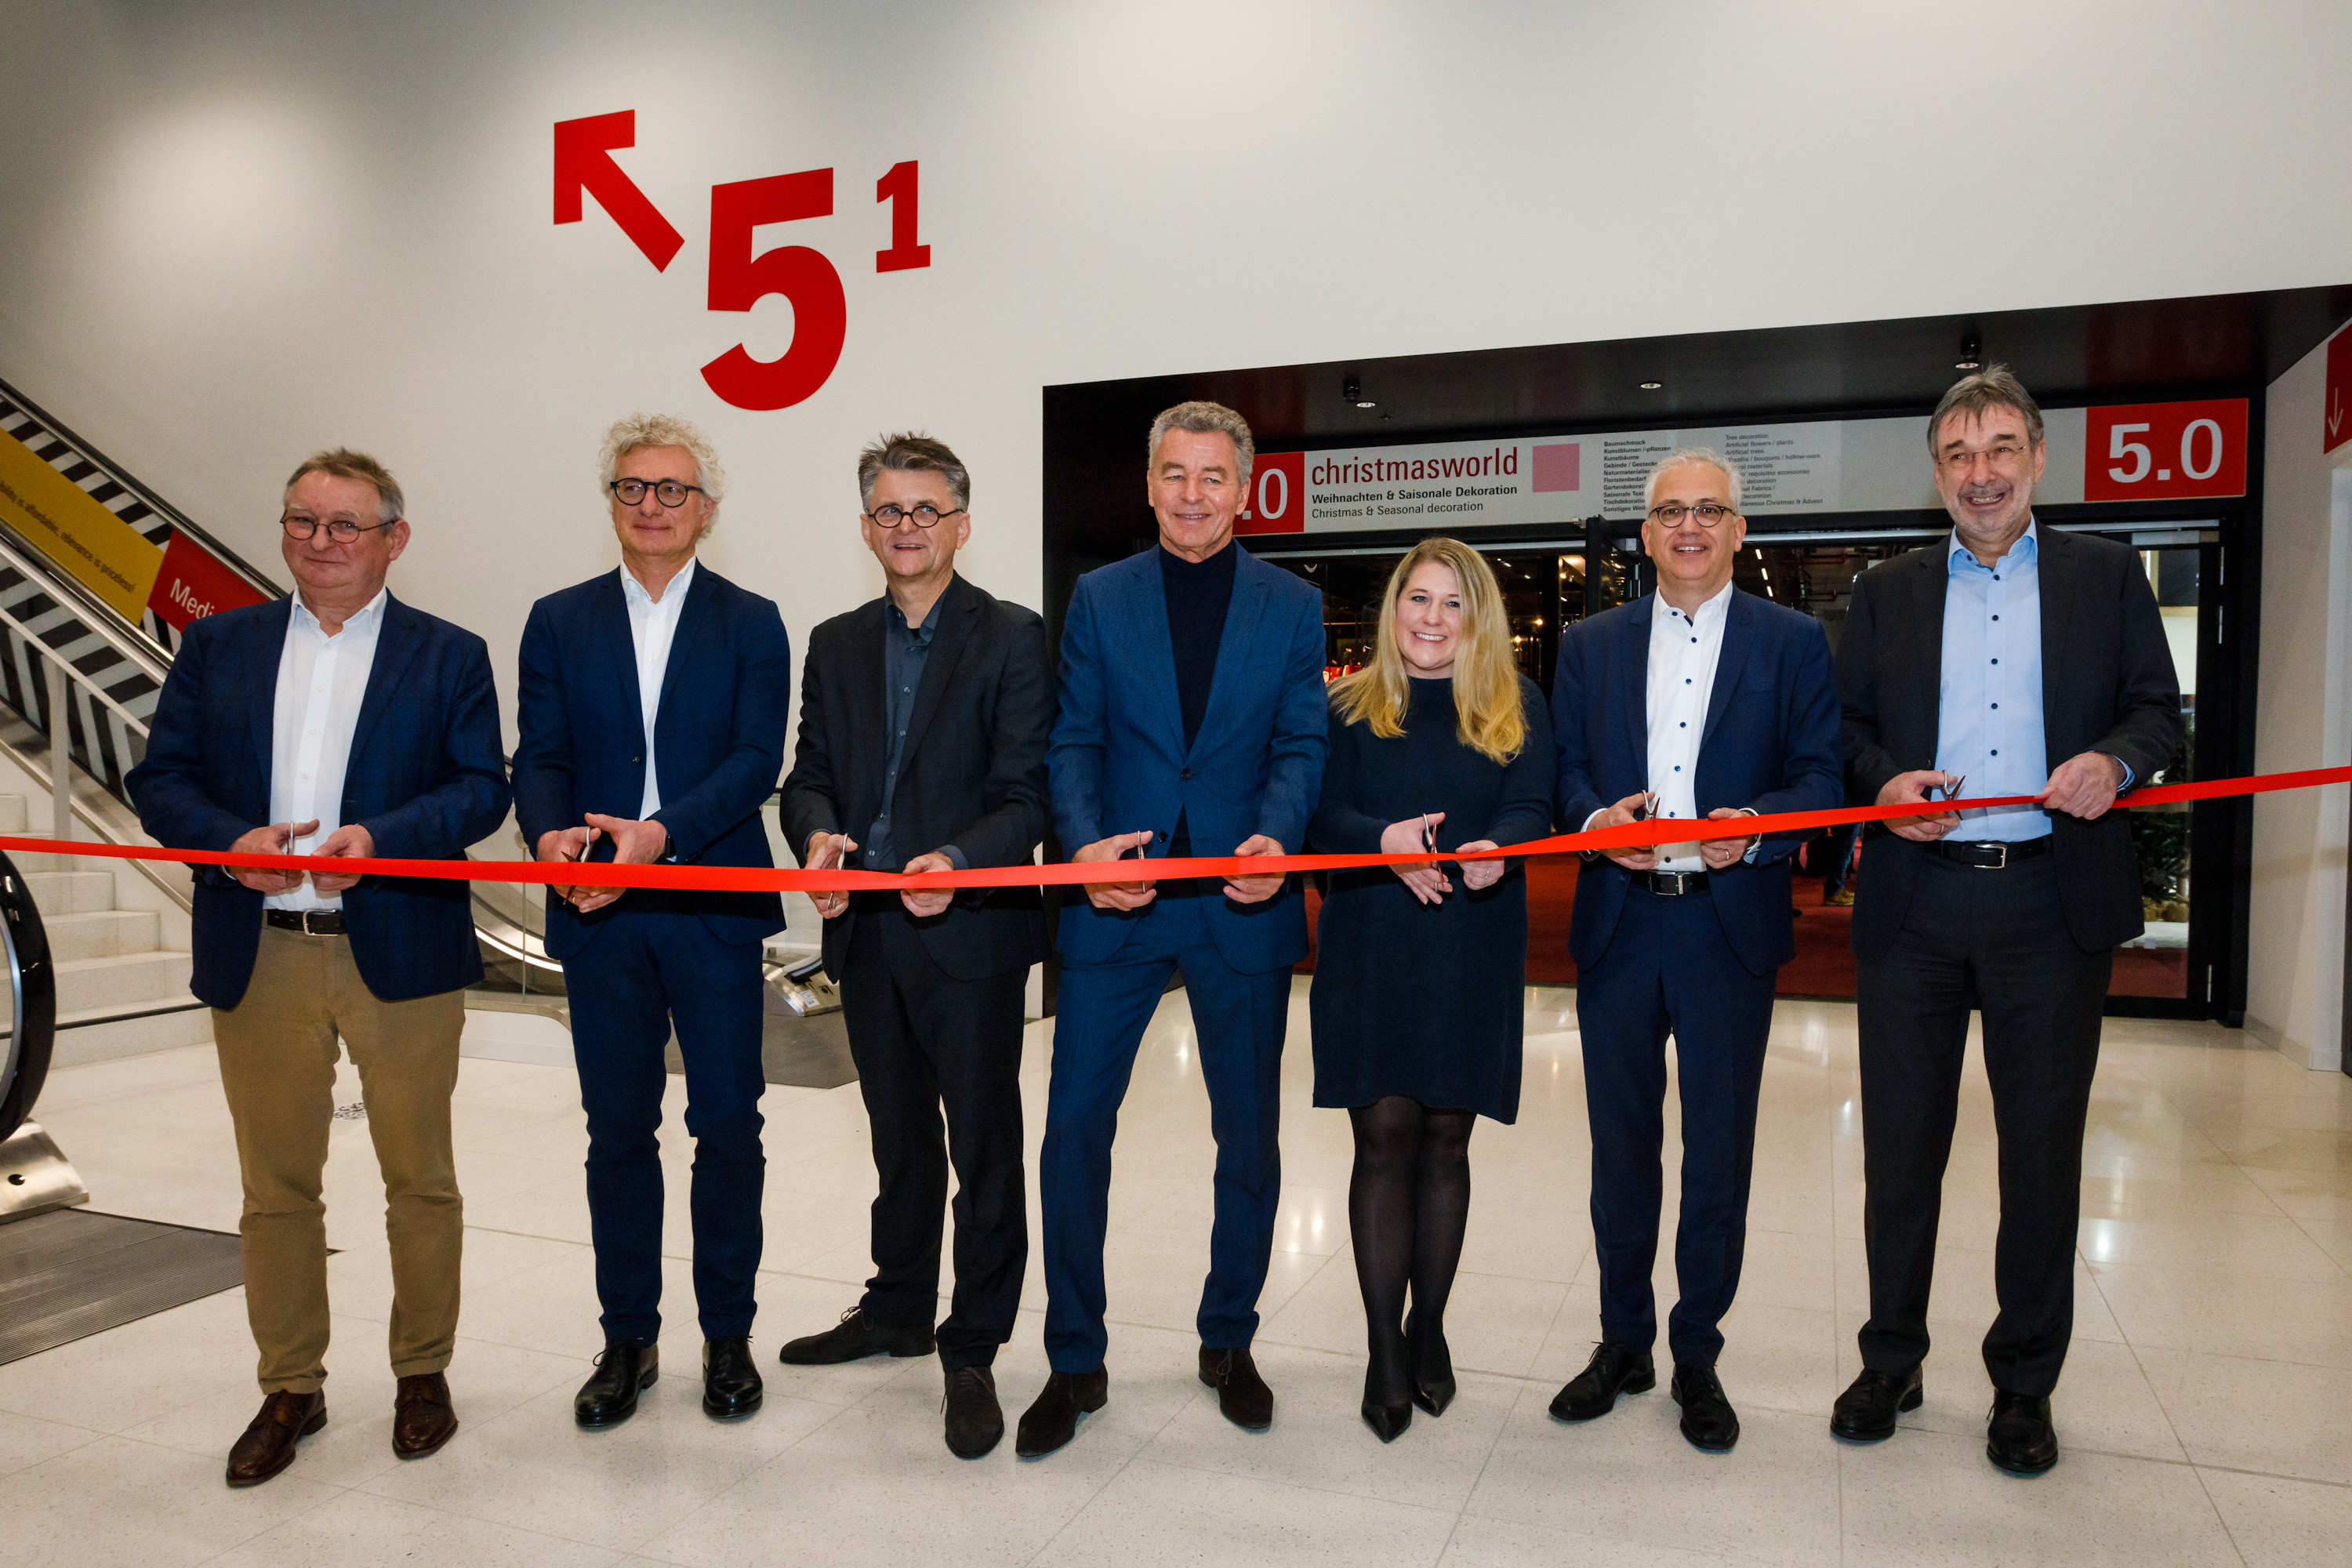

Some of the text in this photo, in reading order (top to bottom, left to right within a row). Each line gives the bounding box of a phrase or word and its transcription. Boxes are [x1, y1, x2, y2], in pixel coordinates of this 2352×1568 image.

[1312, 446, 1518, 485] christmasworld
[2108, 418, 2223, 484] 5.0
[1242, 468, 1288, 520] .0
[1312, 485, 1518, 504] Weihnachten & Saisonale Dekoration
[1312, 501, 1483, 519] Christmas & Seasonal decoration
[169, 577, 215, 619] Medi
